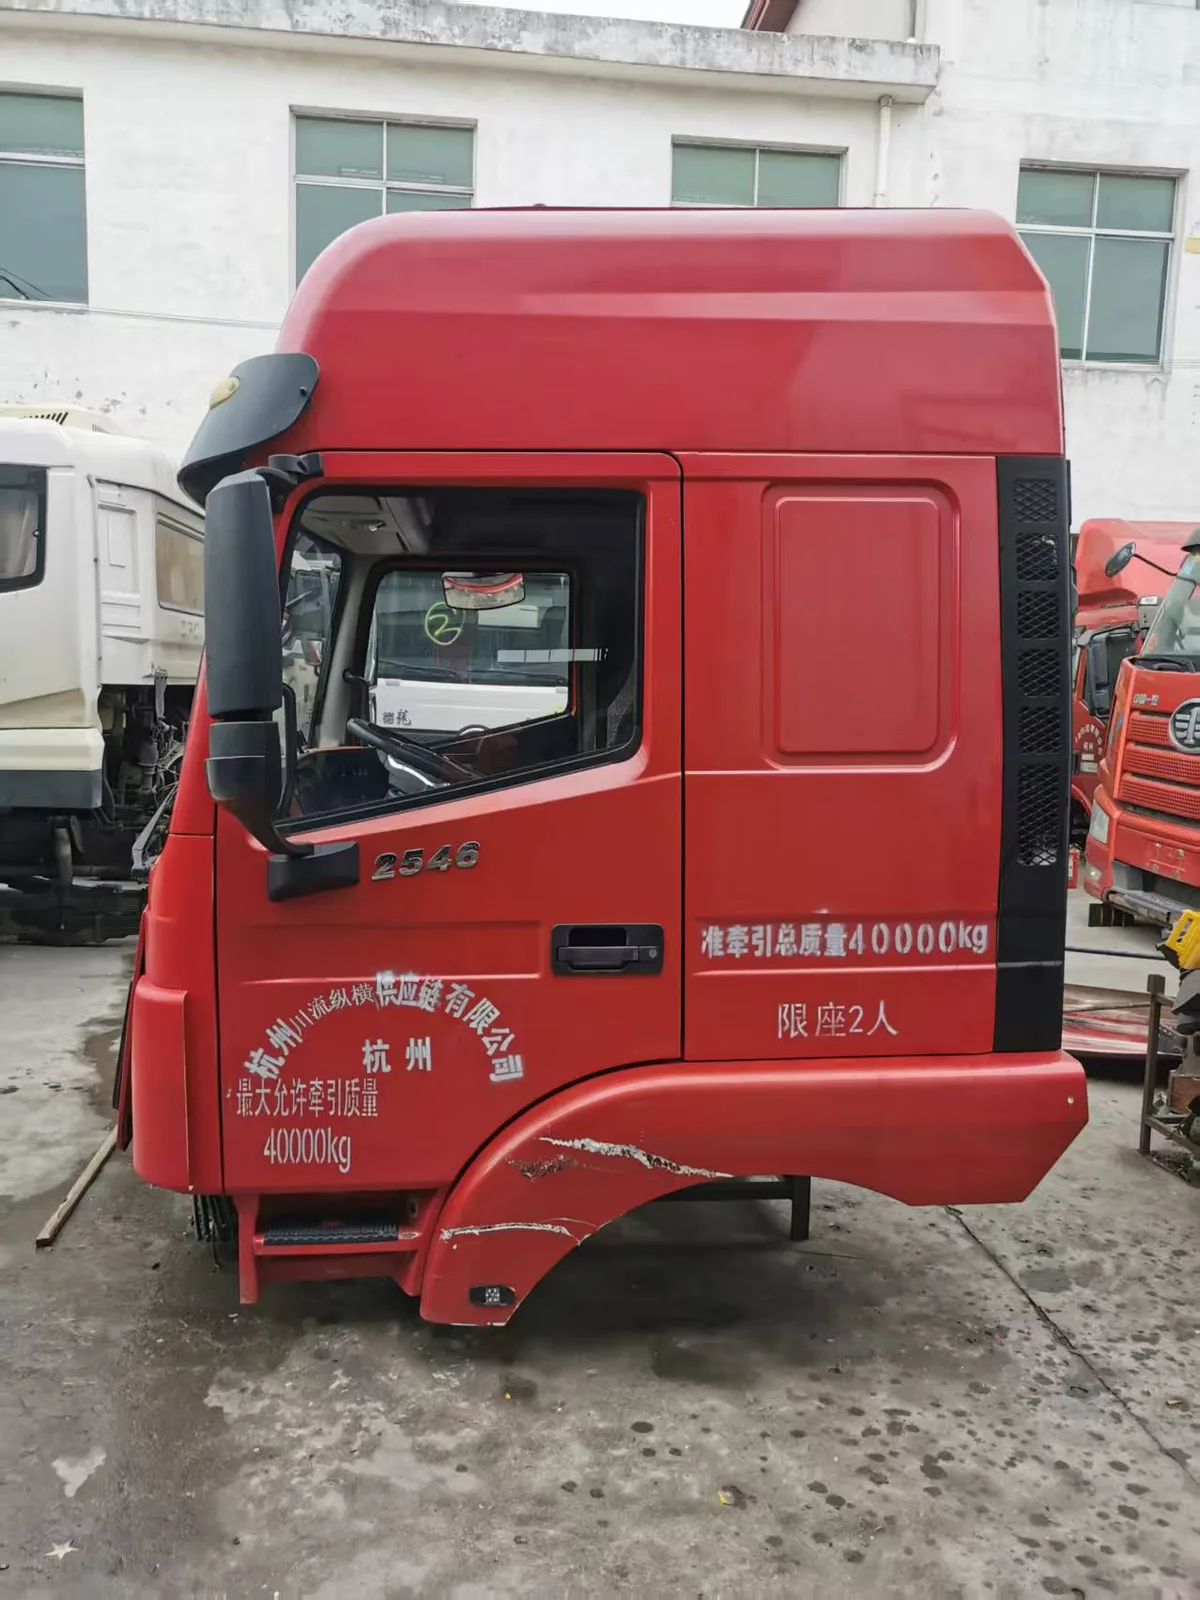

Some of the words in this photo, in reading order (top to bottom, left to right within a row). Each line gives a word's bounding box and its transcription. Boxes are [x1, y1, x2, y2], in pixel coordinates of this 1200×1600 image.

[370, 839, 480, 881] 2546
[776, 1000, 899, 1040] 限座2人
[361, 1036, 433, 1074] 杭州
[235, 1077, 379, 1118] 最大允许牵引质量
[263, 1127, 352, 1174] 40000kg
